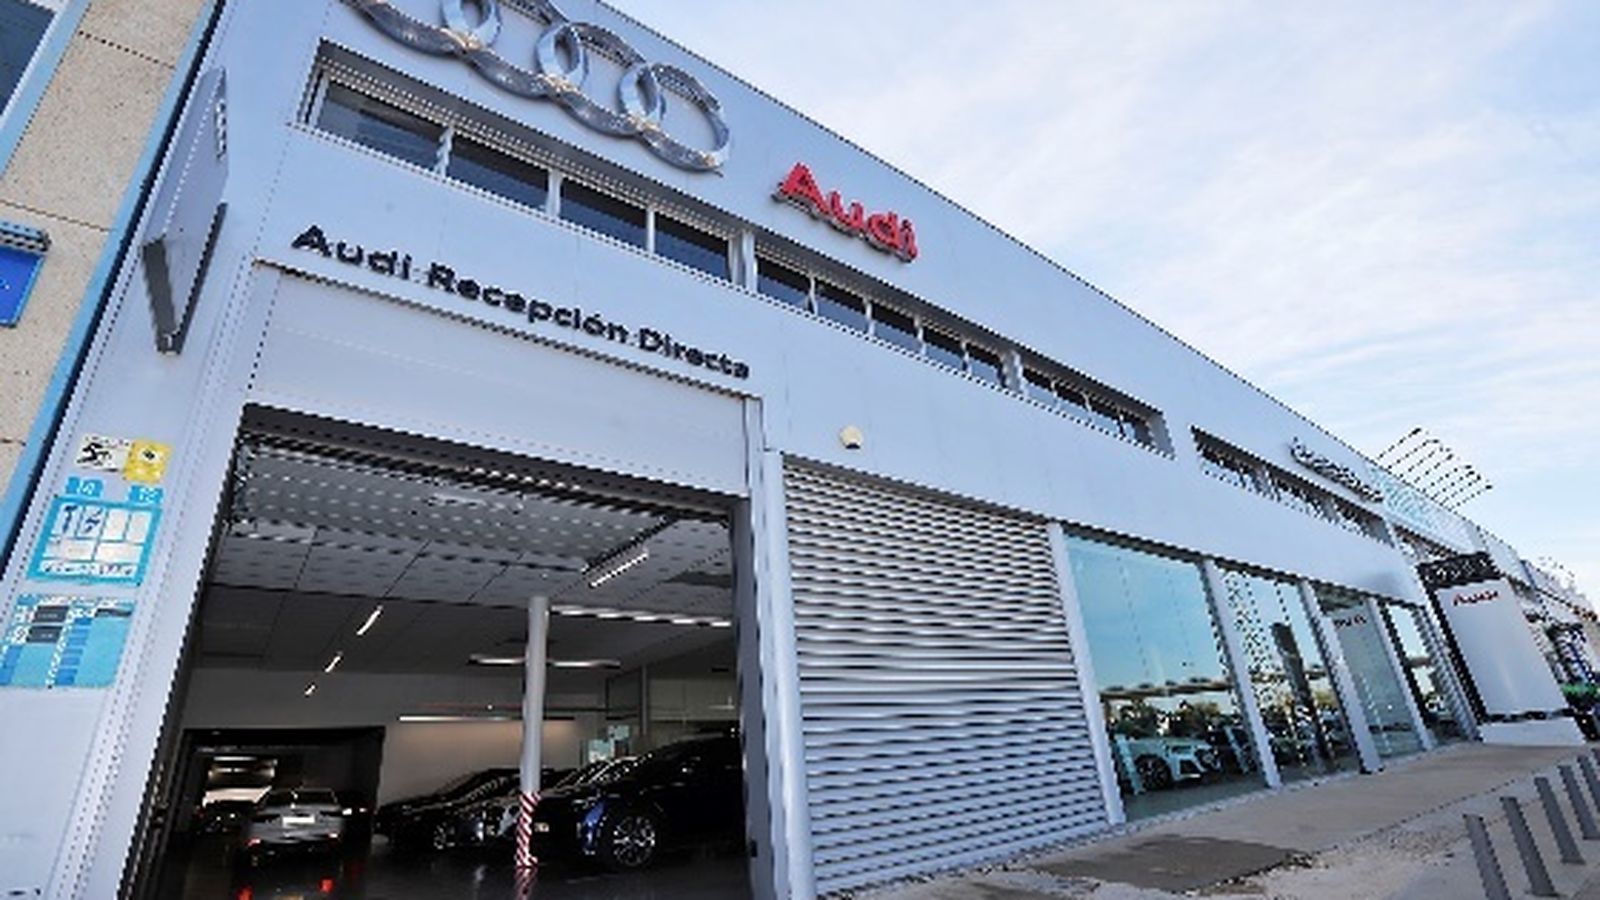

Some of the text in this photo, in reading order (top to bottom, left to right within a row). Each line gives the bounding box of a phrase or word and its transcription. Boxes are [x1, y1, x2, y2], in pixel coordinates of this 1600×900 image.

[772, 161, 918, 262] Audi
[290, 224, 750, 381] Audi Recepción Directa
